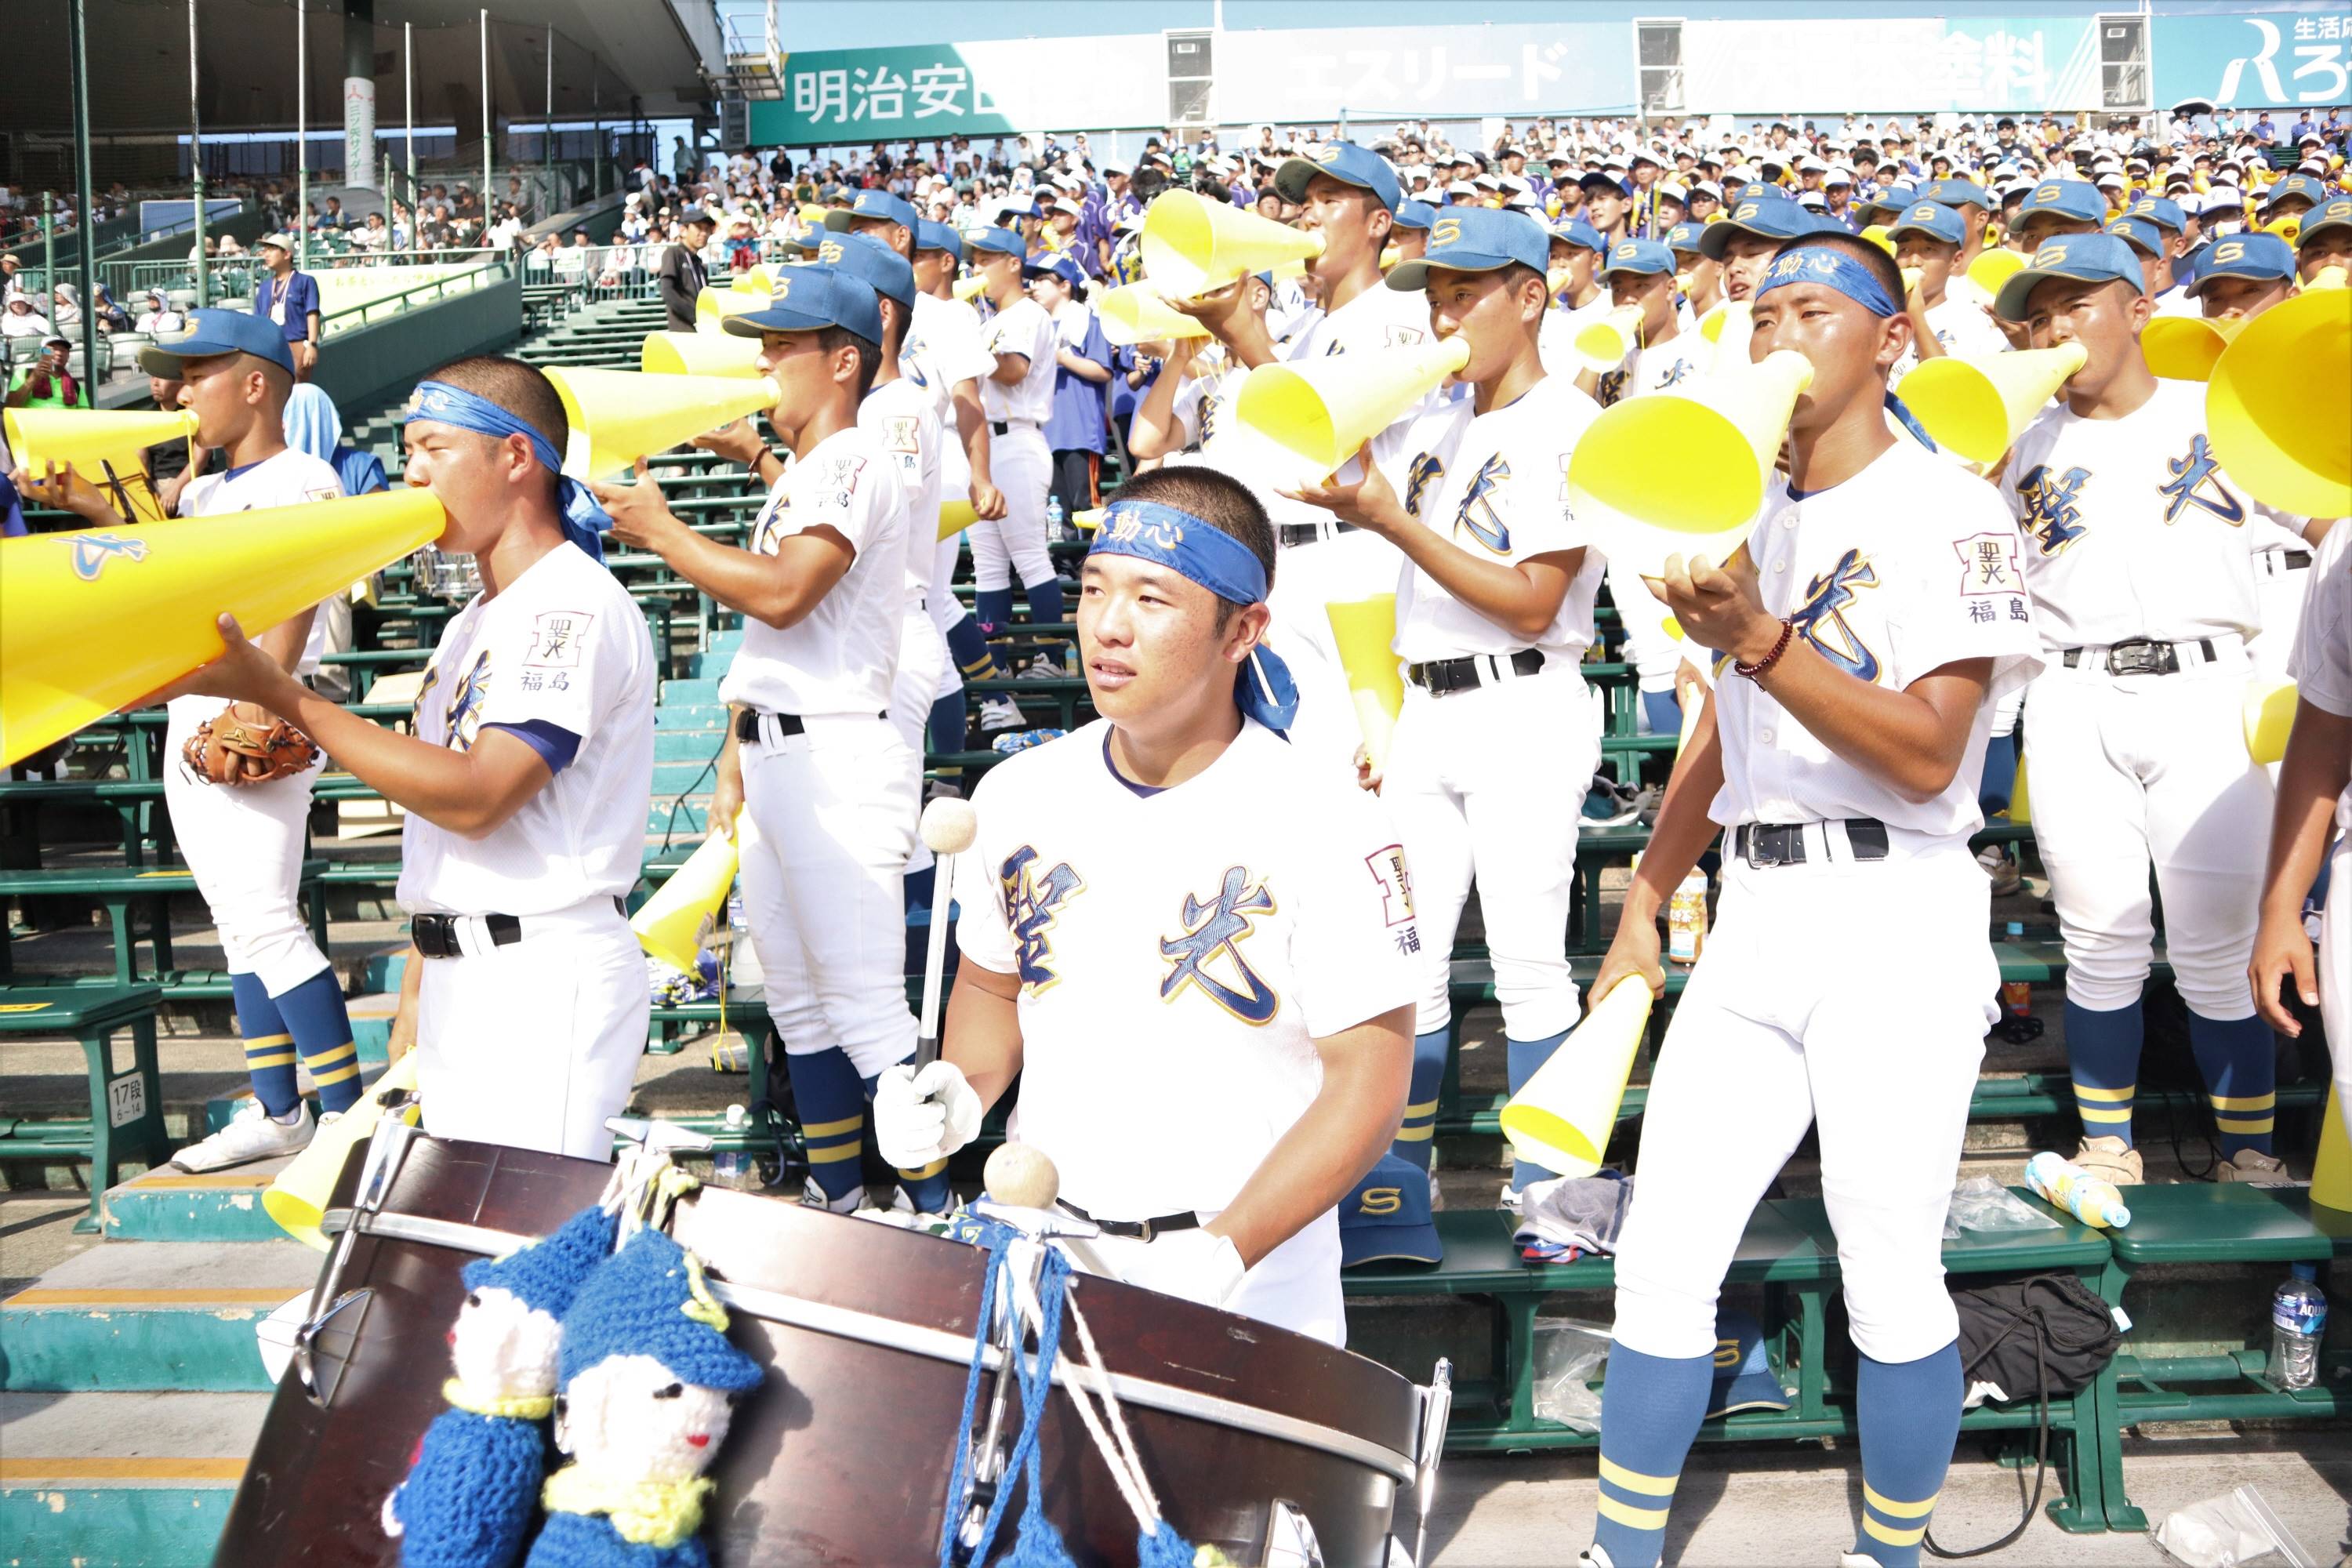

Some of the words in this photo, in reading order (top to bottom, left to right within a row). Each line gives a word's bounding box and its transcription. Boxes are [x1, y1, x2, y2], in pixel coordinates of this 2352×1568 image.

[1286, 42, 1568, 100] エスリード
[793, 64, 996, 123] 明治安
[1317, 146, 1343, 165] S
[1744, 184, 1764, 197] S
[2035, 185, 2062, 204] S
[2286, 177, 2307, 190] S
[1872, 190, 1889, 205] S
[2135, 199, 2157, 214] S
[1734, 203, 1759, 220] S
[1913, 206, 1936, 221] S
[1431, 217, 1462, 249] S
[1555, 221, 1573, 234] S
[1673, 227, 1690, 242] S
[1616, 243, 1638, 260] S
[2031, 245, 2069, 268] S
[2213, 241, 2245, 265] S
[2157, 433, 2245, 528] 光
[1453, 450, 1513, 557] 光
[1968, 597, 2029, 624] 福島
[520, 670, 570, 691] 福島
[1157, 866, 1278, 1028] 光
[114, 1080, 142, 1106] 17段
[1359, 1187, 1402, 1214] S
[1714, 1339, 1740, 1368] S
